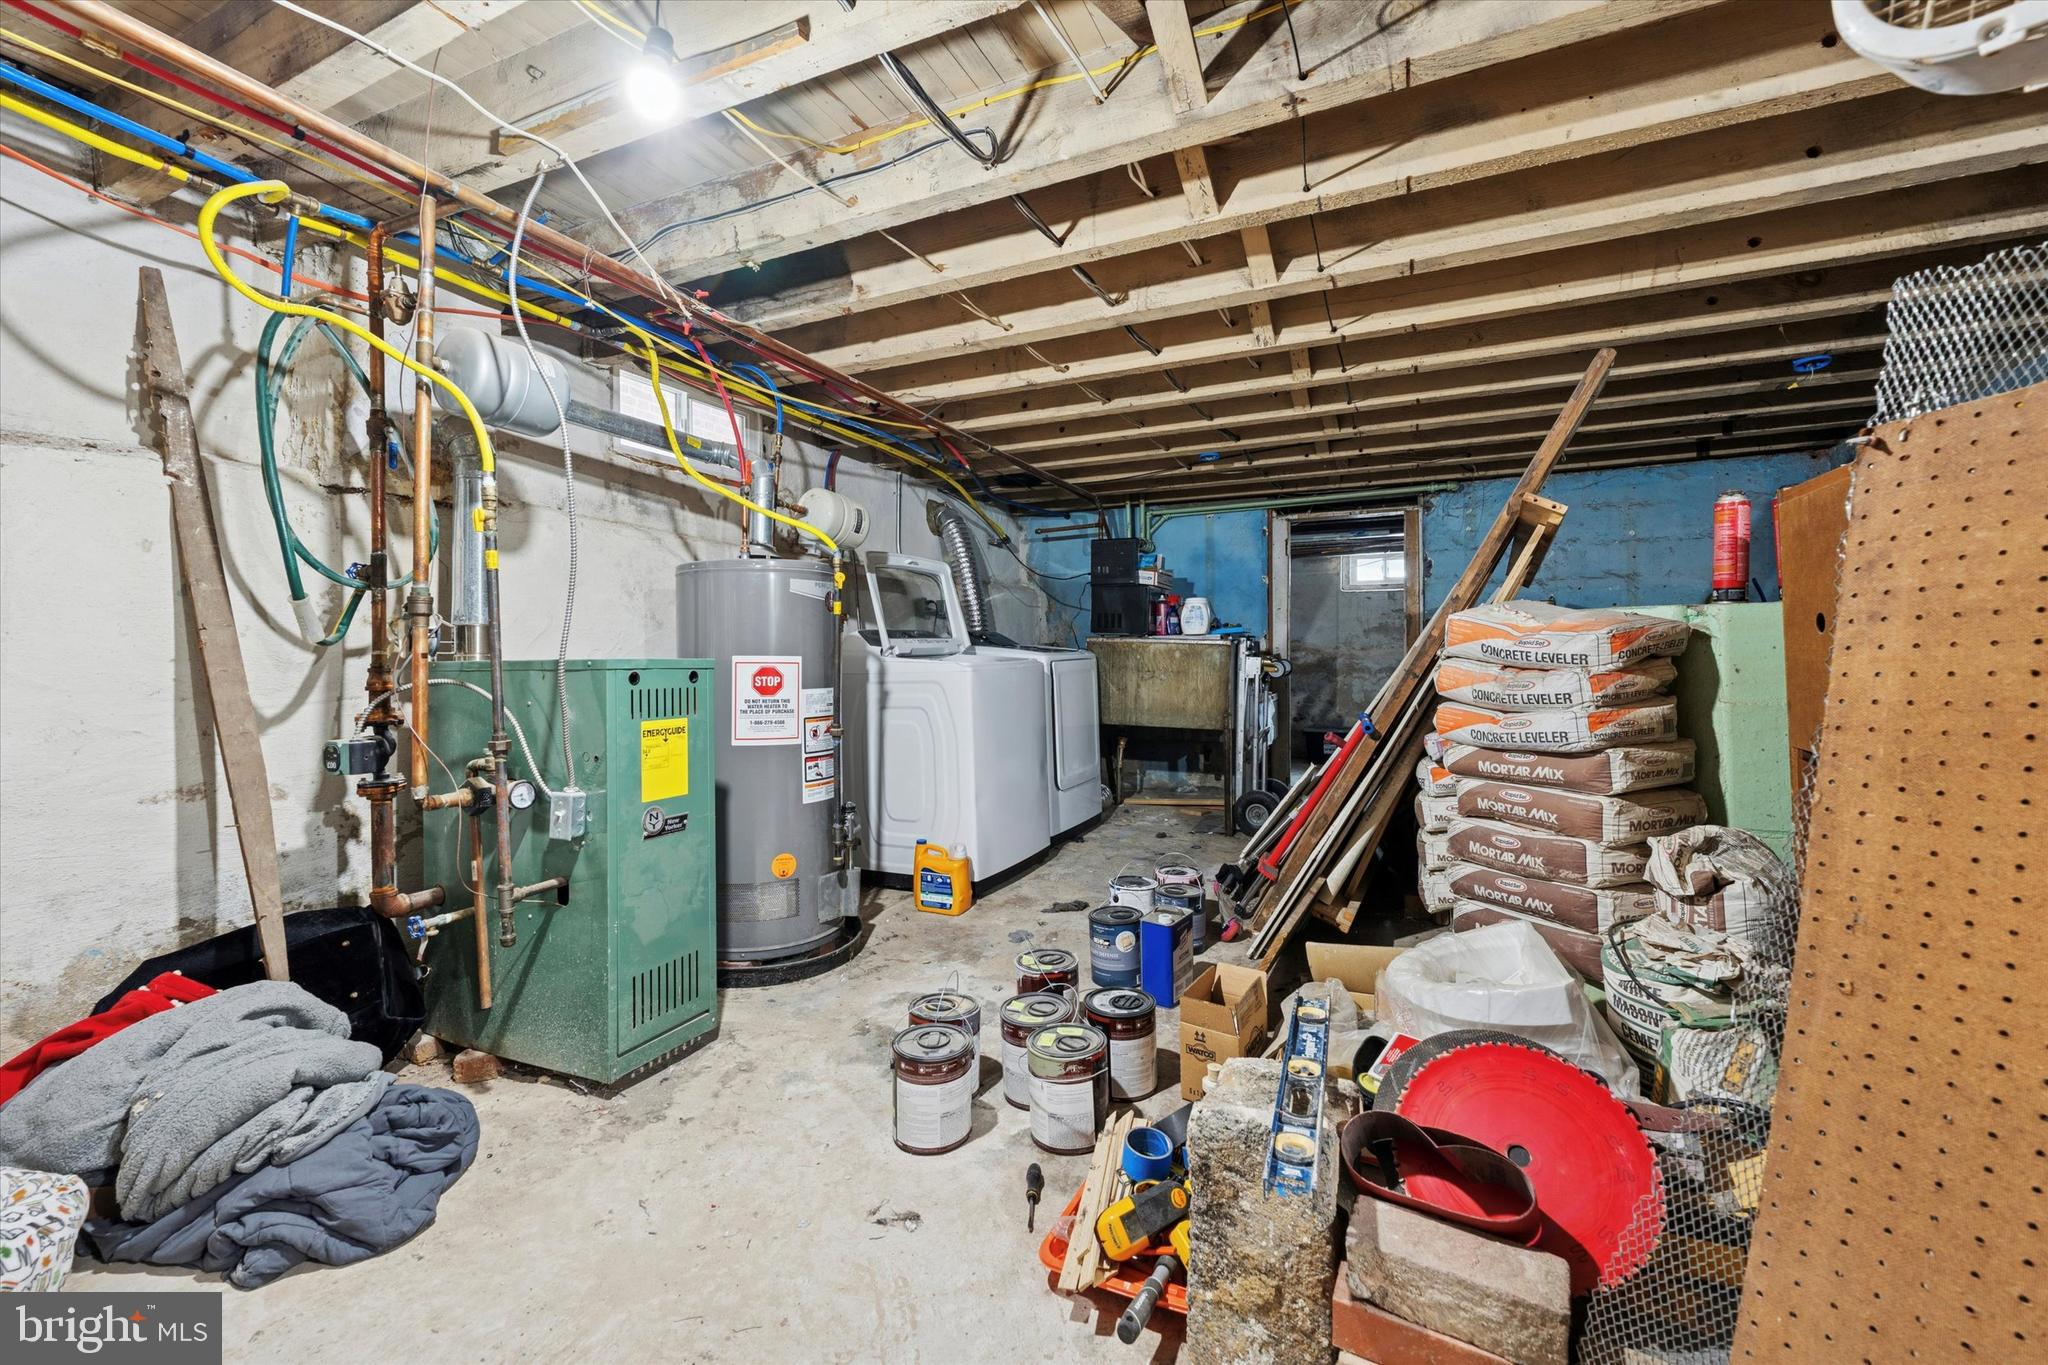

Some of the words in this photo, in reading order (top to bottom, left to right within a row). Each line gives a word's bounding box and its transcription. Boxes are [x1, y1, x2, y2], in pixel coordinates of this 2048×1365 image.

[1480, 643, 1532, 662] CONCRETE
[1535, 652, 1589, 665] LEVELER
[754, 676, 781, 687] STOP
[1471, 689, 1518, 704] CONCRETE
[1520, 692, 1573, 705] LEVELER
[642, 726, 686, 739] ENERGYGUIDE
[1470, 729, 1517, 743] CONCRETE
[1519, 731, 1569, 743] LEVELER
[1478, 760, 1531, 777] MORTAR
[1532, 766, 1564, 780] MIX
[1477, 797, 1527, 817] MORTAR
[1528, 807, 1559, 824] MIX
[1629, 818, 1673, 832] MORTAR
[1675, 815, 1696, 826] MIX
[1469, 840, 1516, 863] MORTAR
[1517, 853, 1544, 868] MIX
[1474, 884, 1522, 906] MORTAR
[1525, 897, 1554, 914] MIX
[1187, 1046, 1214, 1059] WATCO
